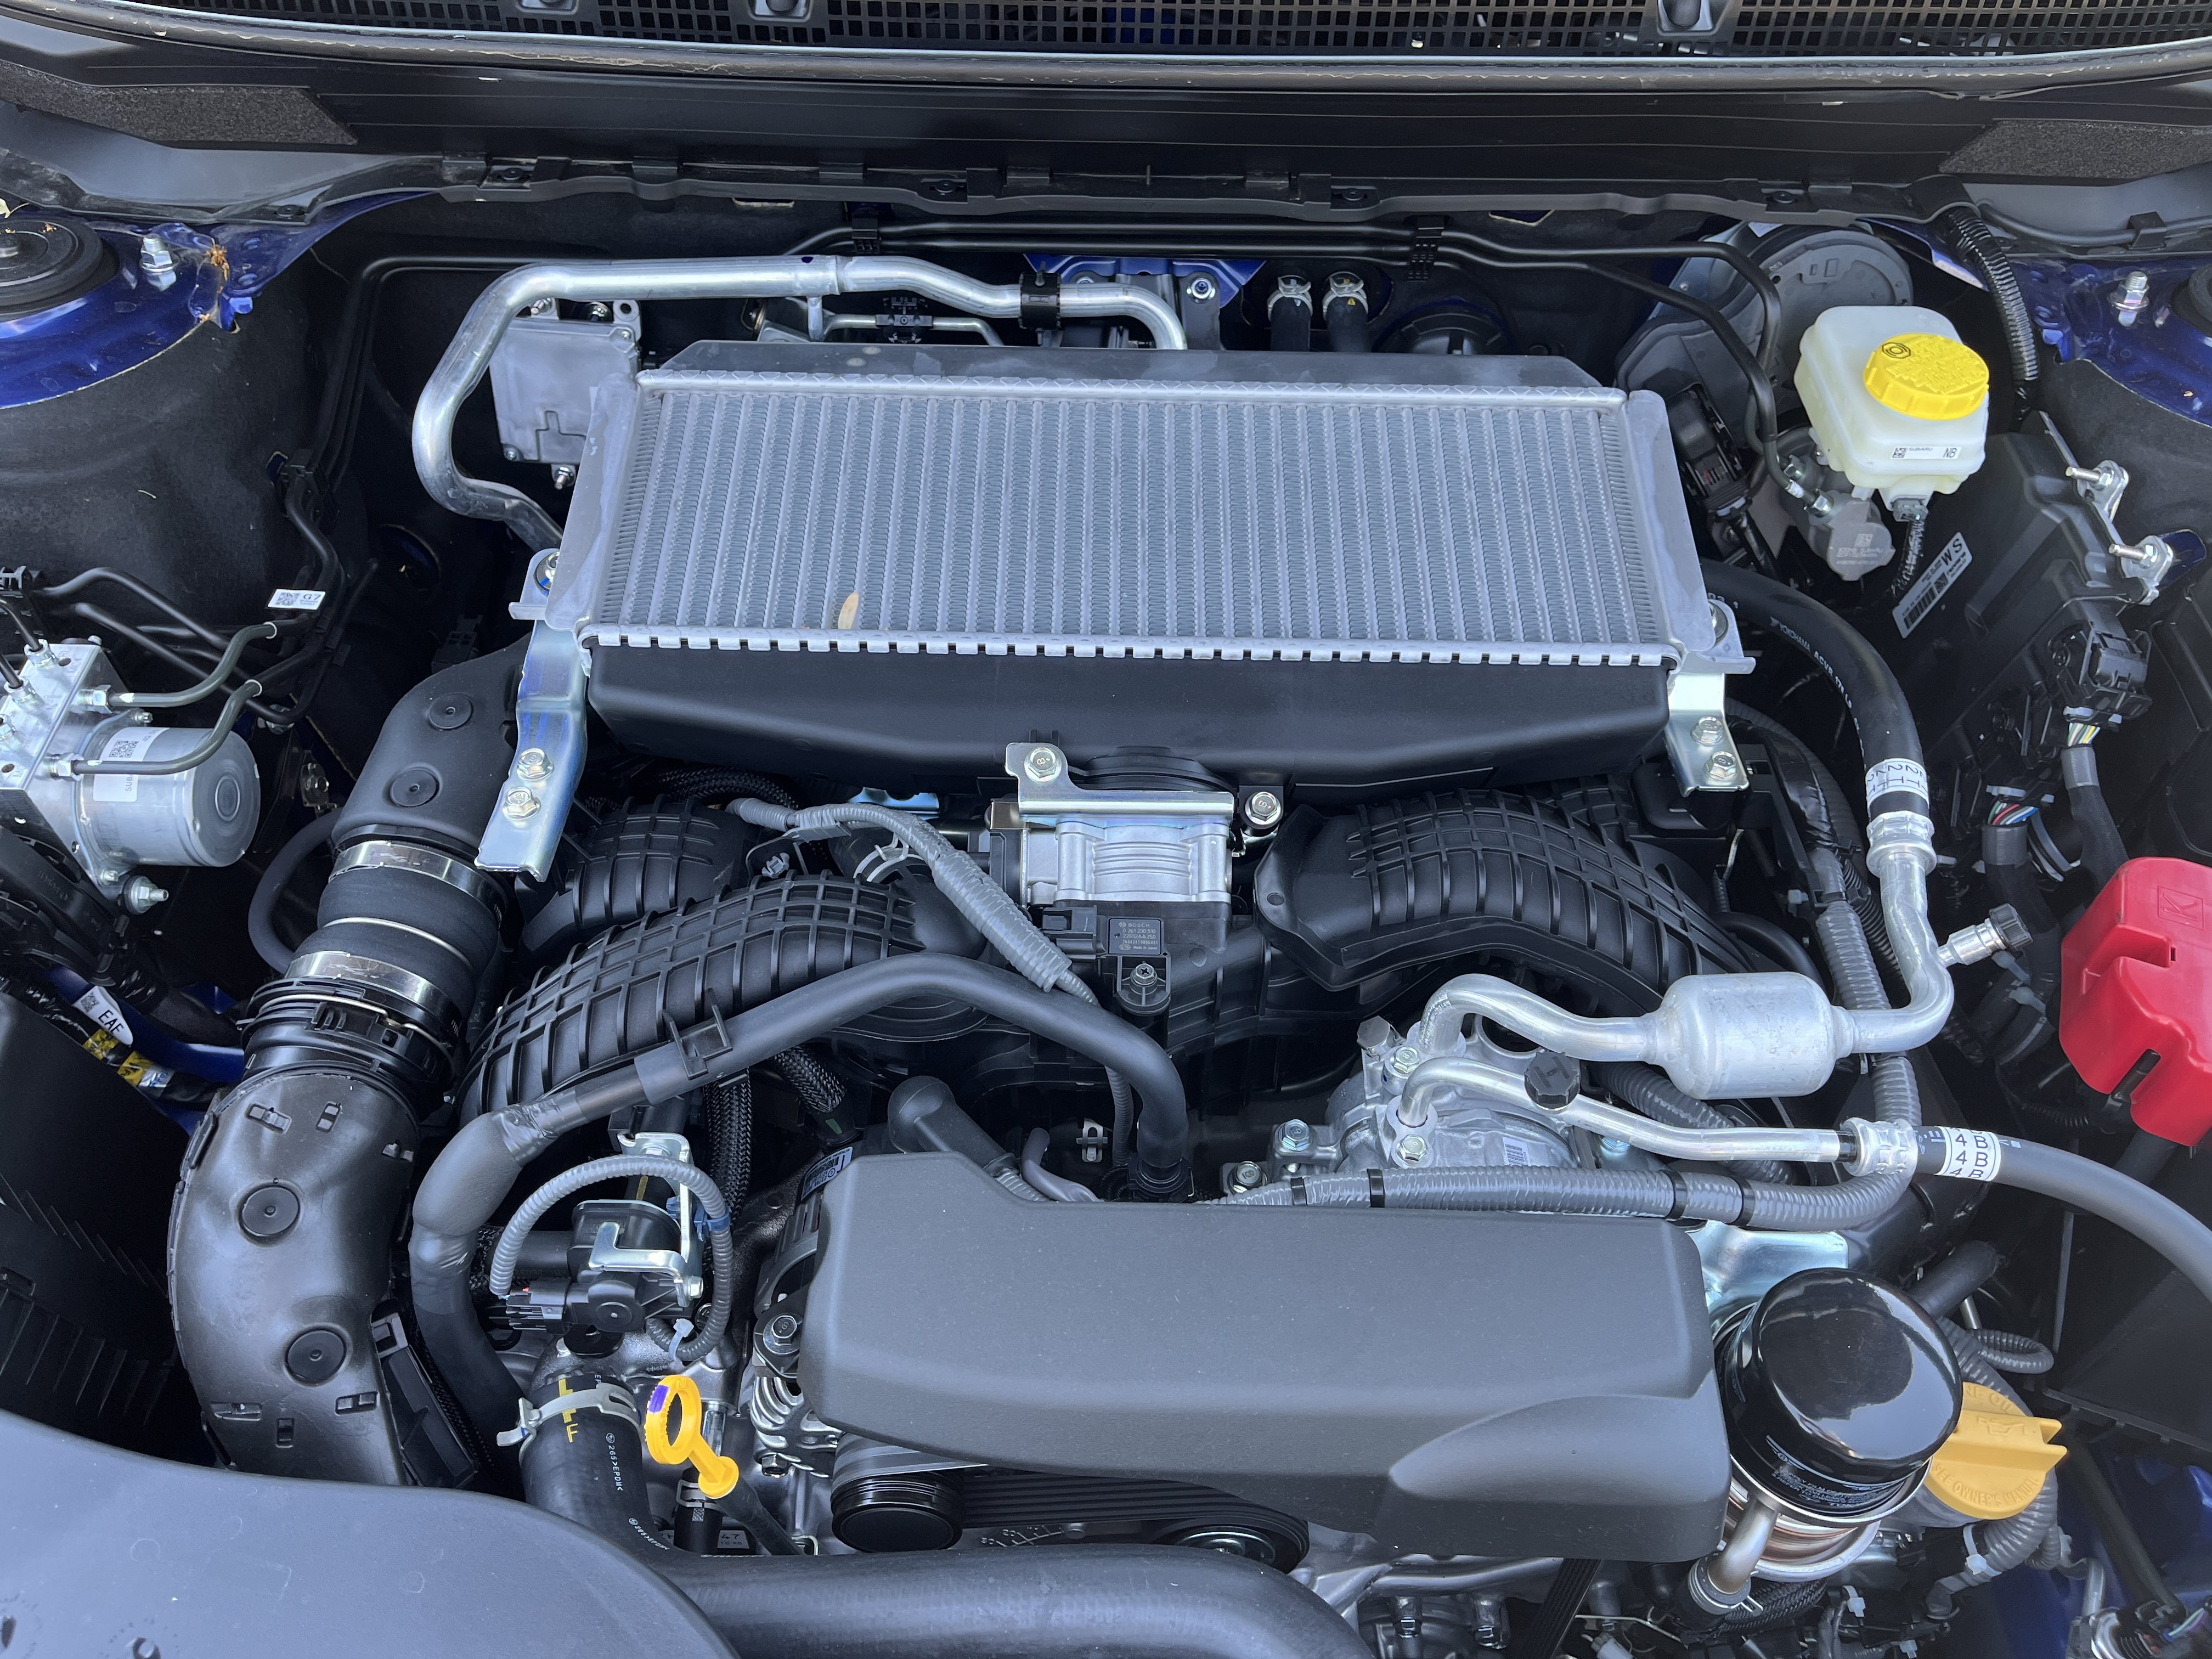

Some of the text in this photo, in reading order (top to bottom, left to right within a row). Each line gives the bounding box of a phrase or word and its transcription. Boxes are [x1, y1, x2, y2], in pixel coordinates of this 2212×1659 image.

[1943, 448, 1957, 458] NB
[98, 1009, 123, 1032] EAF
[566, 1423, 579, 1443] F
[1932, 1463, 2039, 1506] SEE OWNER'S MANUAL
